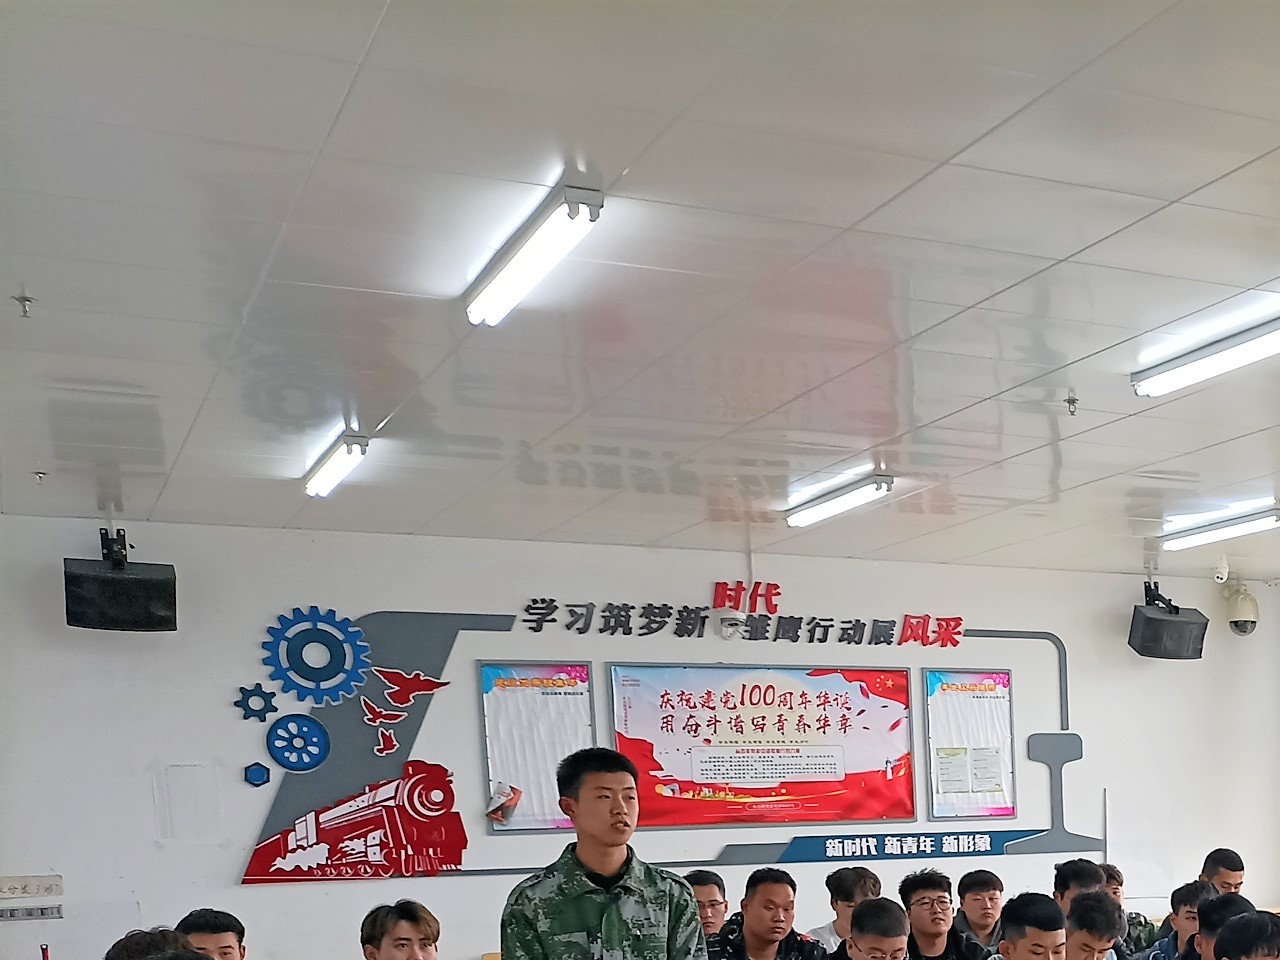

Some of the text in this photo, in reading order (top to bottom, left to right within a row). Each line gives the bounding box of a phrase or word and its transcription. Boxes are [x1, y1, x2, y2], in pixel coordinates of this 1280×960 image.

[659, 684, 852, 711] 庆祝建党100周年华诞
[660, 714, 852, 738] 用奋斗谱写青春华章
[825, 834, 992, 857] 新时代 新青年 新形象
